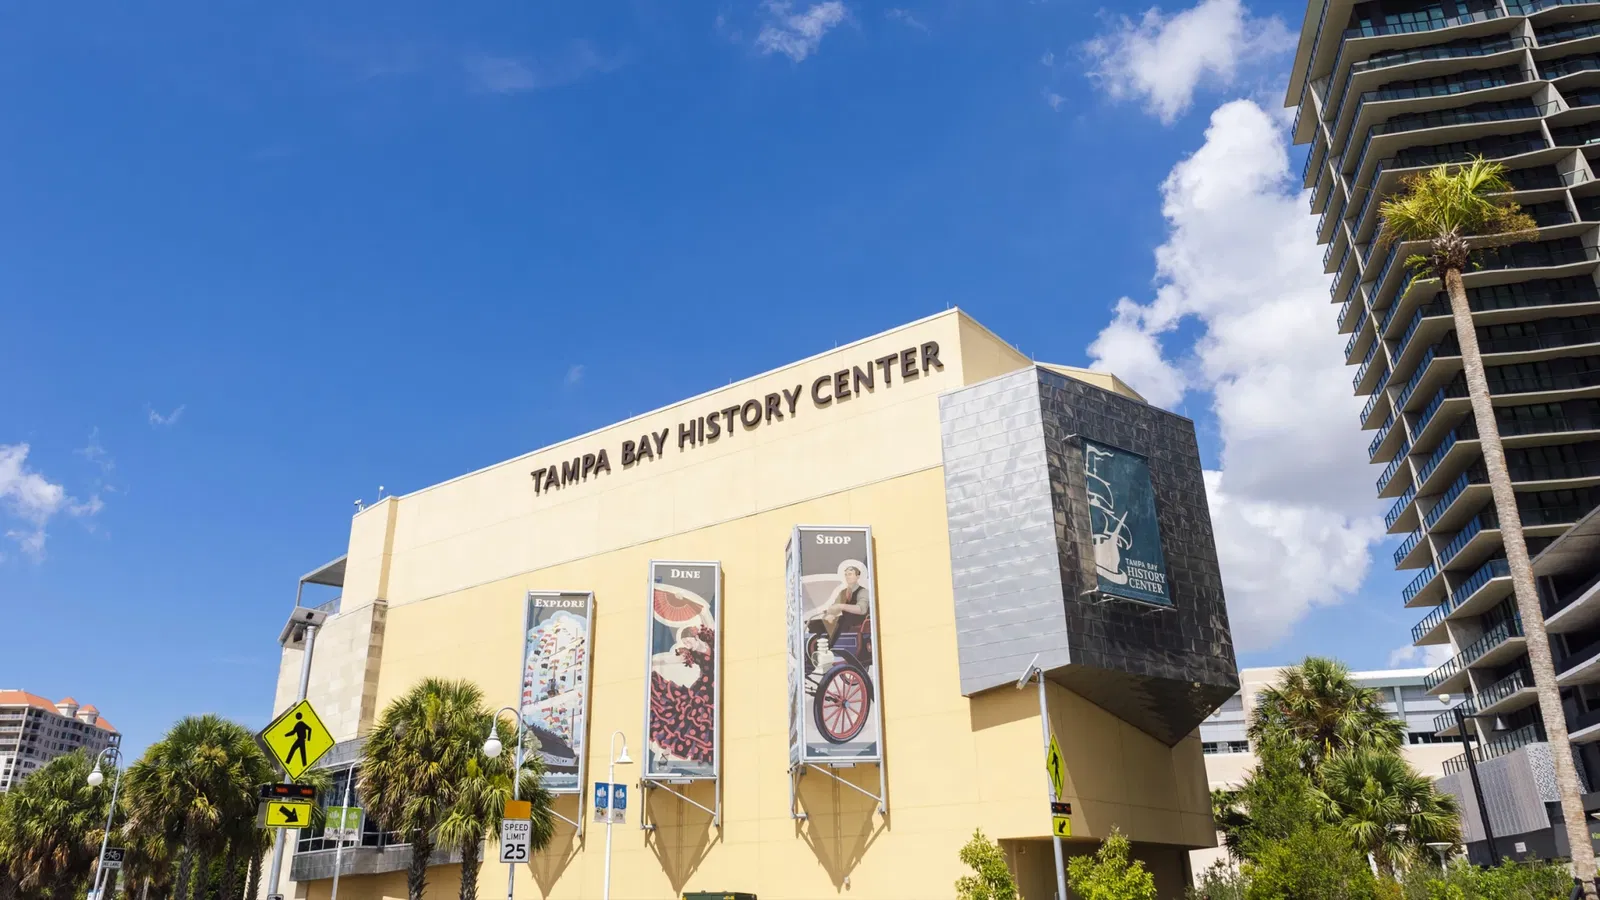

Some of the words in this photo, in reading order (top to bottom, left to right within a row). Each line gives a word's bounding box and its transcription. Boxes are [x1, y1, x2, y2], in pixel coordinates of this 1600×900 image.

[531, 449, 611, 493] TAMPA
[621, 428, 669, 466] BAY
[678, 384, 803, 449] HISTORY
[811, 341, 944, 405] CENTER
[1125, 557, 1146, 569] TAMPA
[1146, 562, 1158, 571] BAY
[1127, 566, 1166, 584] HISTORY
[1129, 577, 1165, 595] CENTER
[504, 823, 529, 832] SPEED
[506, 833, 526, 841] LIMIT
[504, 843, 526, 860] 25
